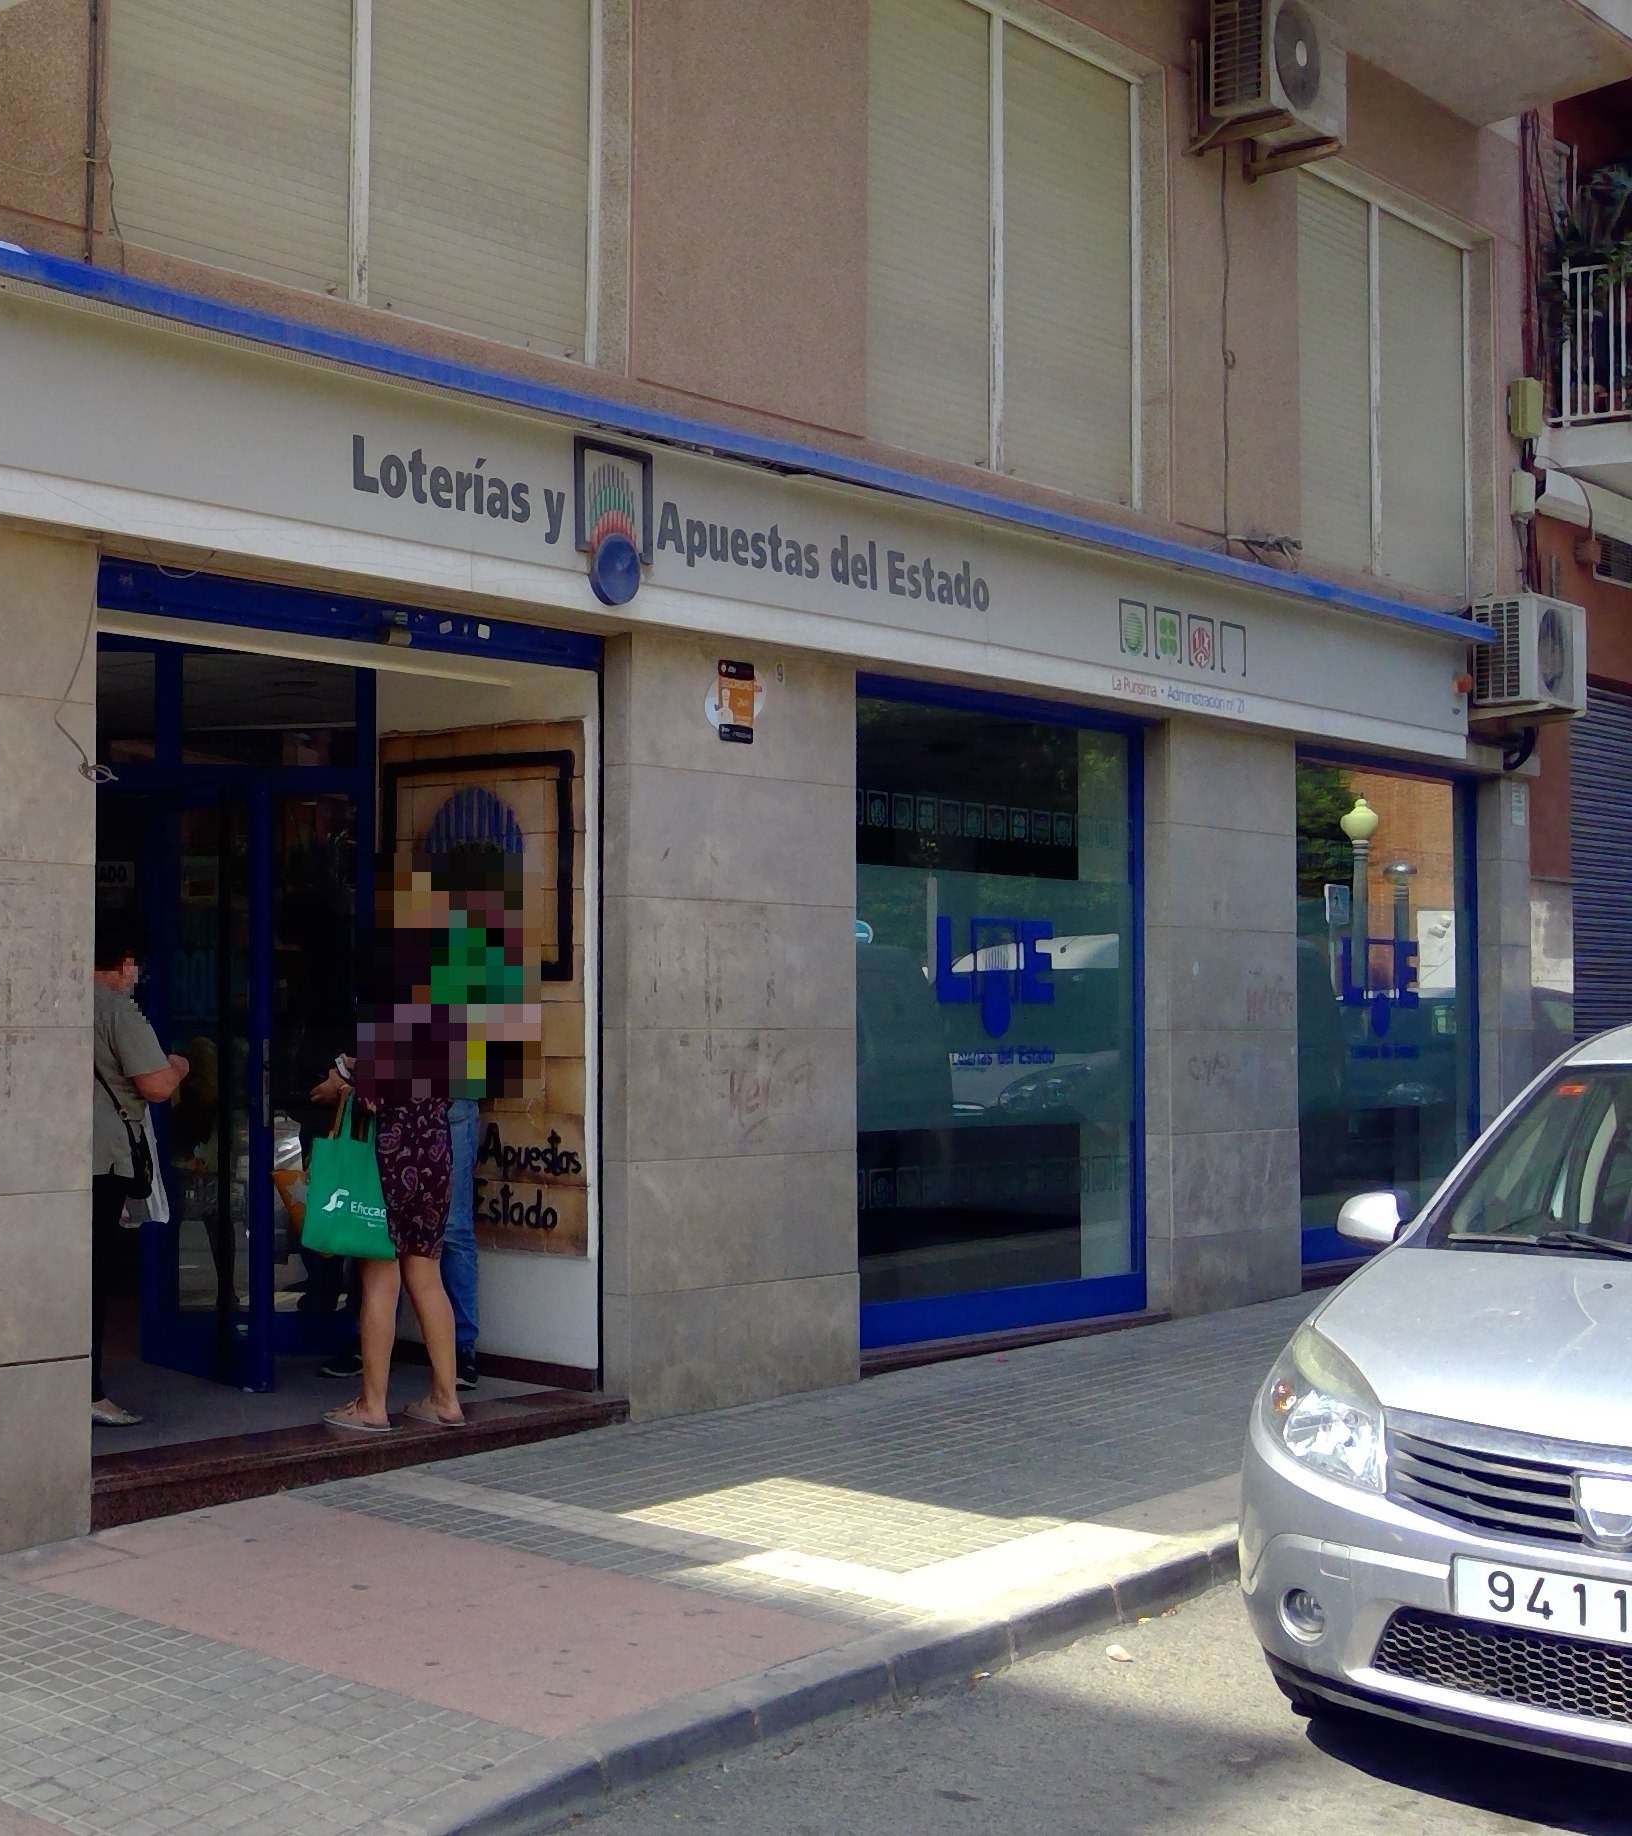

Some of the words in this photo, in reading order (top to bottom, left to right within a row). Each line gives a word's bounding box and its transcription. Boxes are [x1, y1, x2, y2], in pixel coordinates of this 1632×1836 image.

[353, 434, 531, 523] Loterías
[544, 489, 566, 544] y
[657, 502, 819, 579] Apuestas
[831, 535, 878, 590] del
[887, 550, 990, 611] Estado
[1112, 675, 1122, 691] La
[477, 1122, 582, 1179] Apuestas
[473, 1178, 558, 1230] Estado
[1488, 1571, 1627, 1632] 9411
